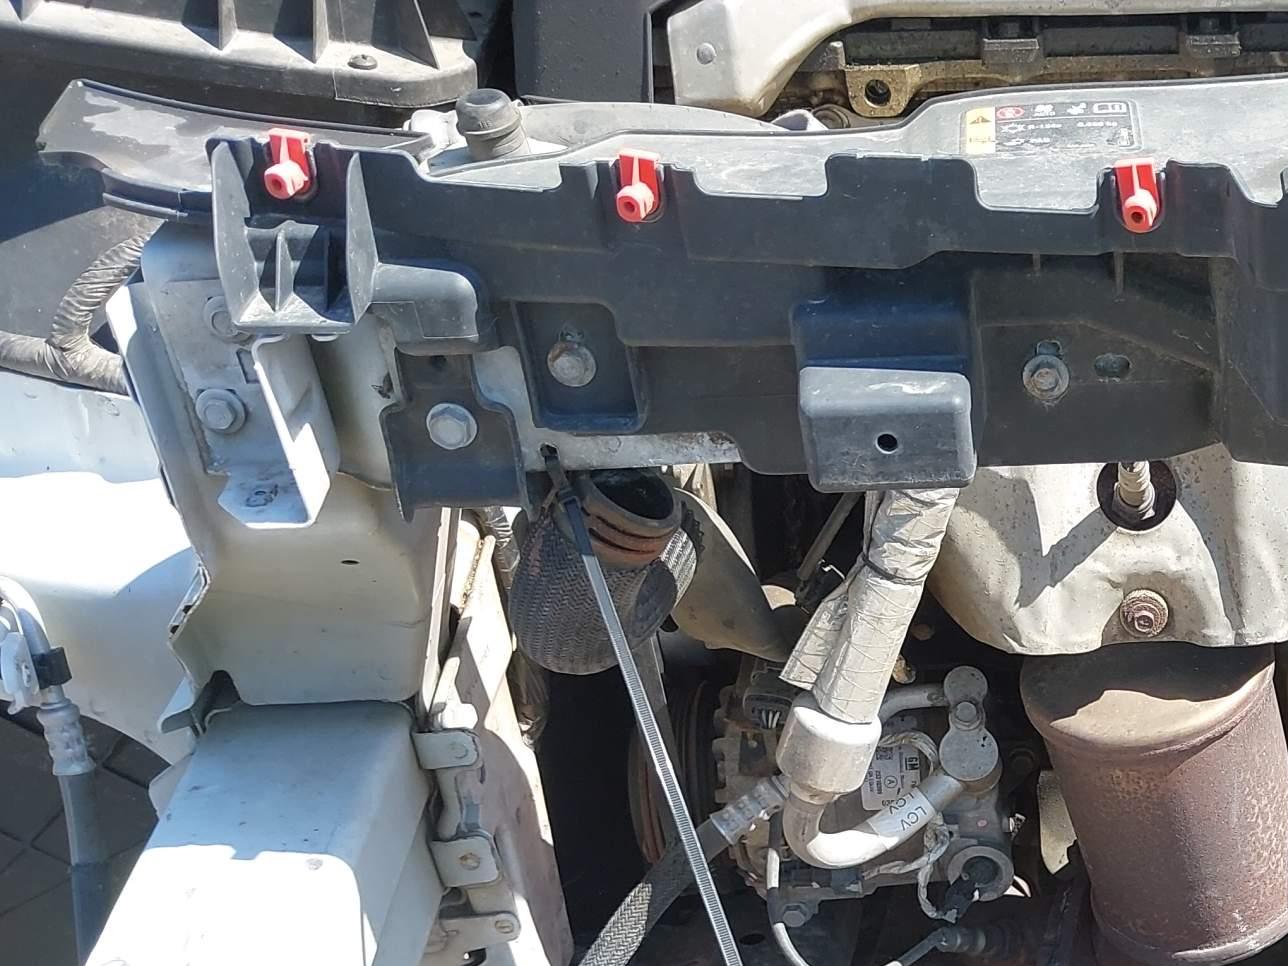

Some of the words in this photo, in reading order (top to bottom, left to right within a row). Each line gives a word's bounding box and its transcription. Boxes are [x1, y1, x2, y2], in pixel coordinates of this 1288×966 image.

[908, 757, 920, 770] GM
[889, 792, 915, 815] LCV
[901, 806, 927, 831] LCV
